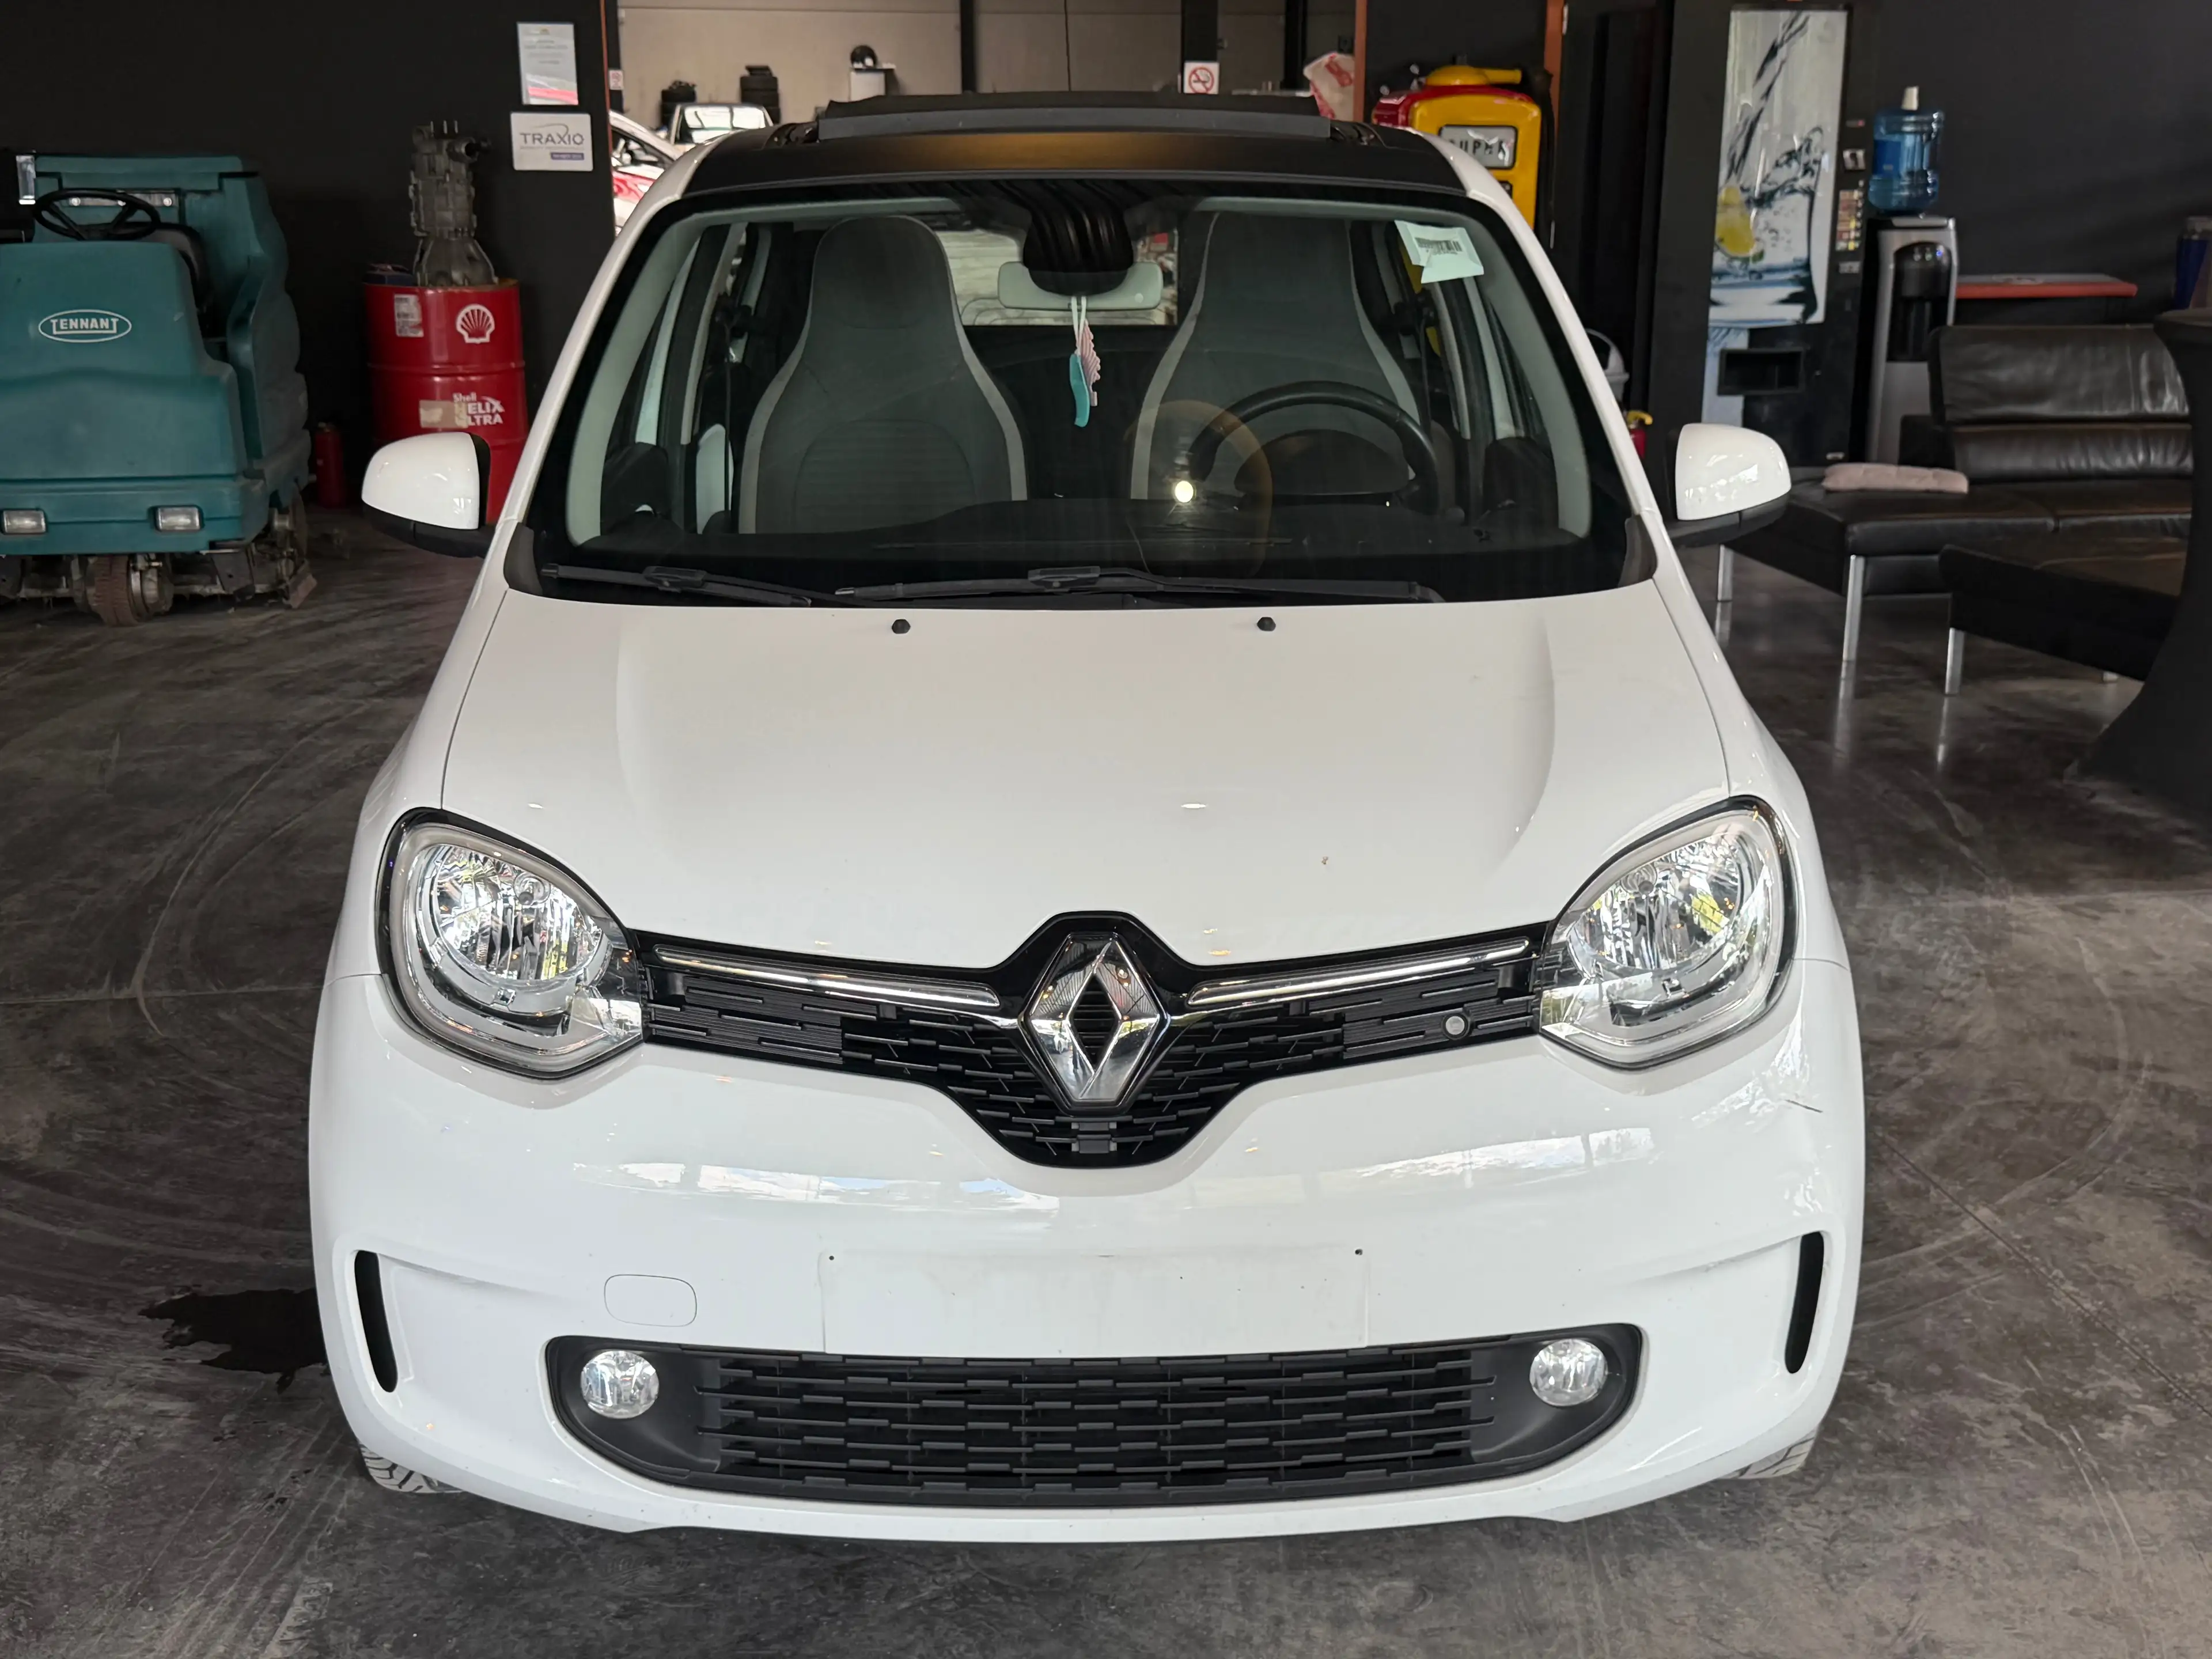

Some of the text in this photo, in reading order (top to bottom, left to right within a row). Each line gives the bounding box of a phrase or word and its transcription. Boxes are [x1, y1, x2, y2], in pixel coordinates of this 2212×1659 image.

[520, 131, 585, 145] TRAXIO
[1449, 139, 1510, 157] UPER
[50, 318, 119, 334] TENNANT
[452, 392, 476, 402] Shell
